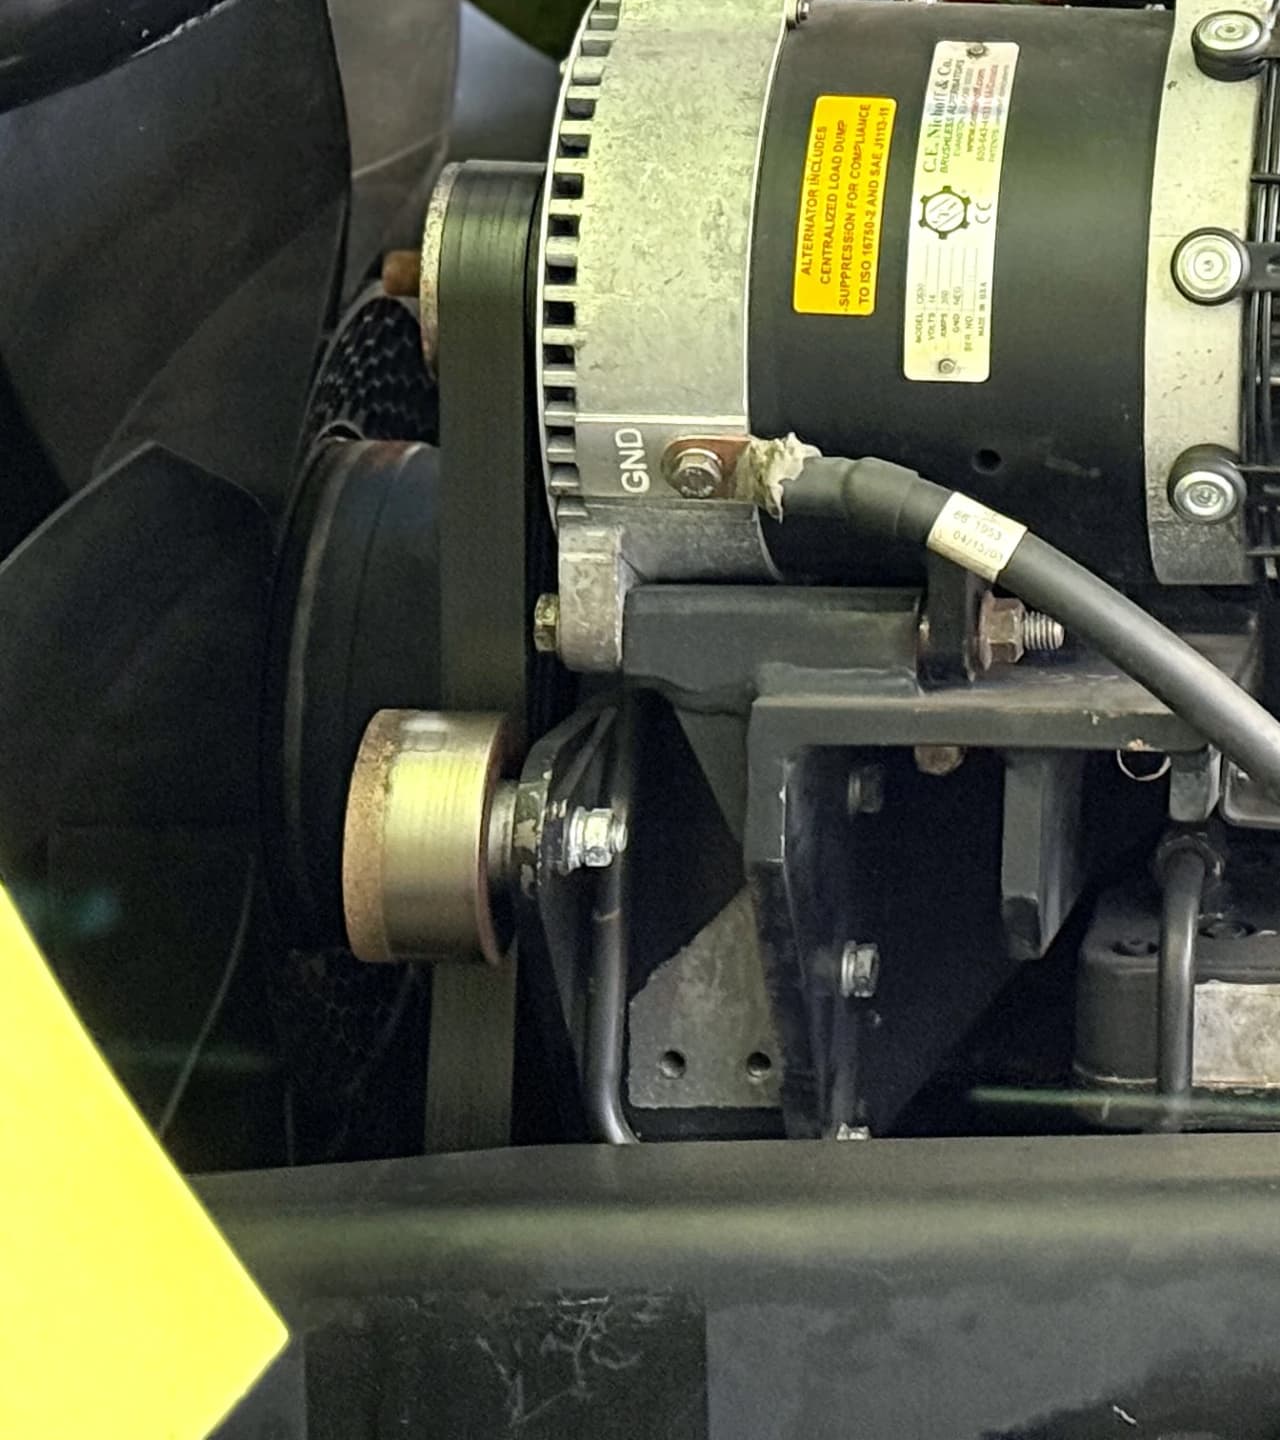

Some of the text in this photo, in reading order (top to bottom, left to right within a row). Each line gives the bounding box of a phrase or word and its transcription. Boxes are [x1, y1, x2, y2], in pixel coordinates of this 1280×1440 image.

[801, 126, 827, 276] ALTERNATOR INCLUDES
[820, 120, 848, 285] CENTRALIZED LOAD DUMP
[839, 104, 871, 307] SUPPRESSION FOR COMPLIANCE
[858, 107, 890, 305] TO ISO 16750-2 AND SAE J1113-11
[915, 312, 924, 344] MODEL
[927, 312, 936, 340] VOLTS
[615, 427, 650, 493] GND
